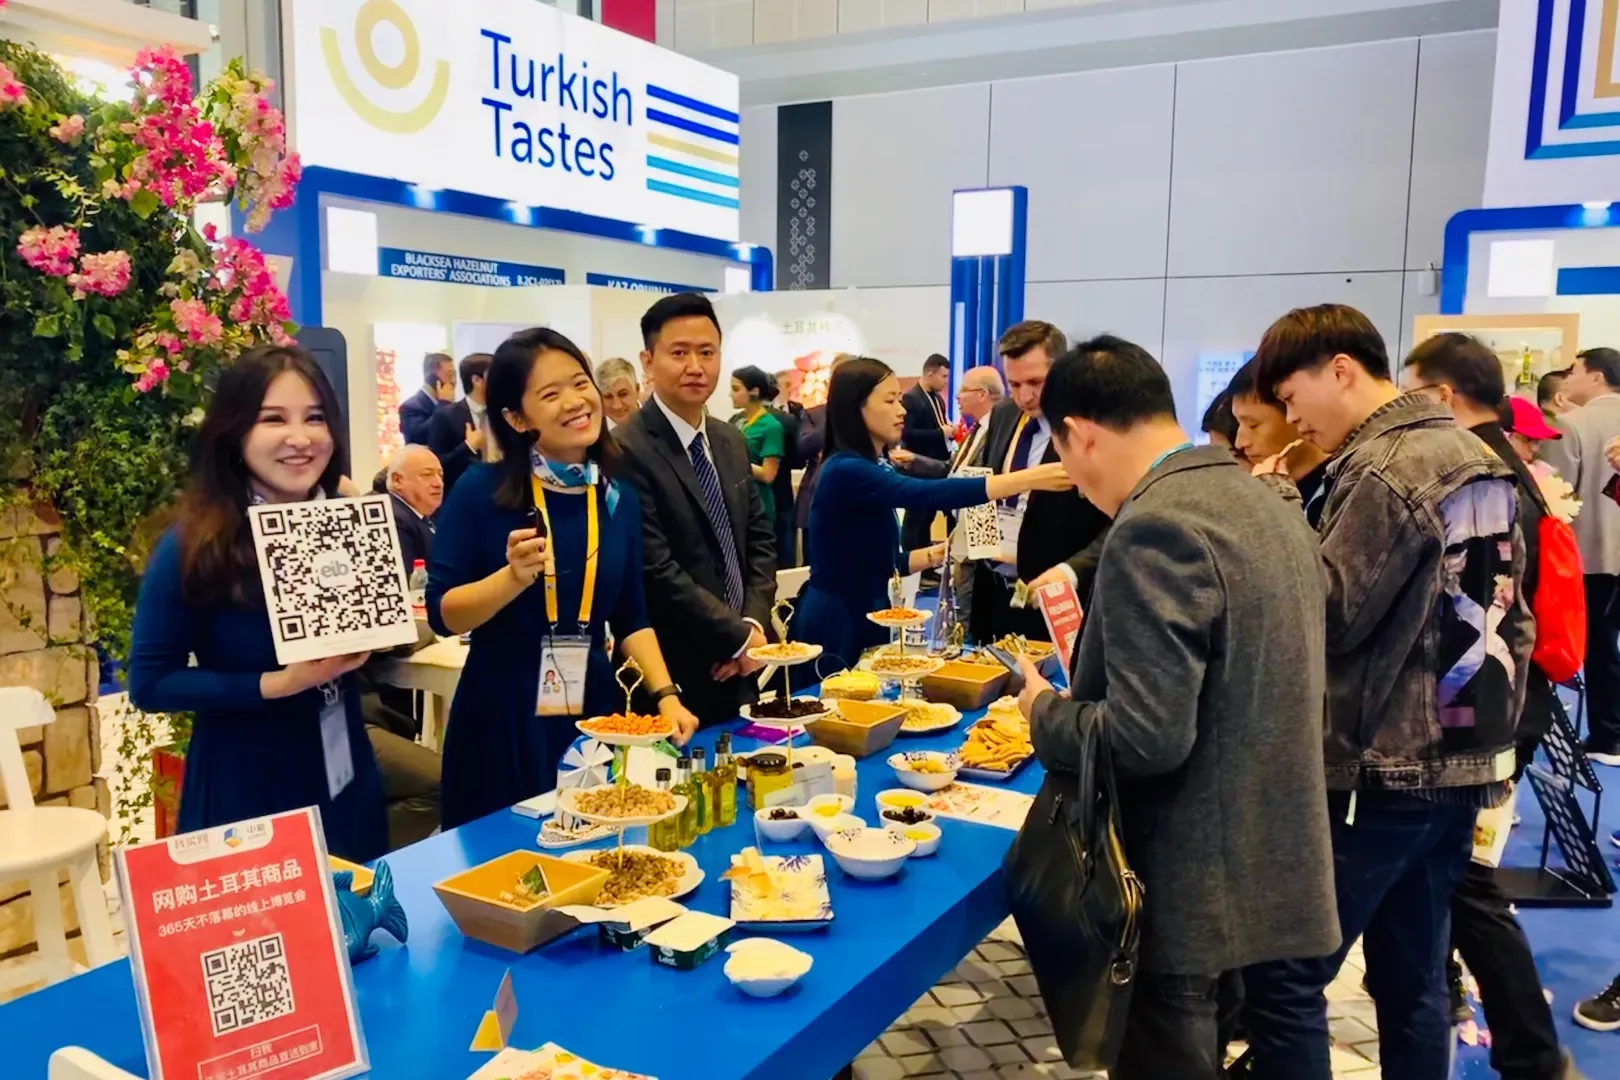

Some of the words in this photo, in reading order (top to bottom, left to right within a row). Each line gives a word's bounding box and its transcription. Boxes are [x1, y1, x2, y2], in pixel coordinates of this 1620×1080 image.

[480, 28, 633, 126] Turkish
[481, 97, 615, 182] Tastes
[391, 263, 447, 281] EXPORTERS'
[449, 270, 511, 287] ASSOCIATIONS
[405, 252, 452, 269] BLACKSEA
[453, 258, 499, 274] HAZELNUT
[320, 561, 349, 579] eib
[152, 858, 303, 914] 网购土耳其商品
[158, 888, 307, 938] 365天不落幕的线上博览会
